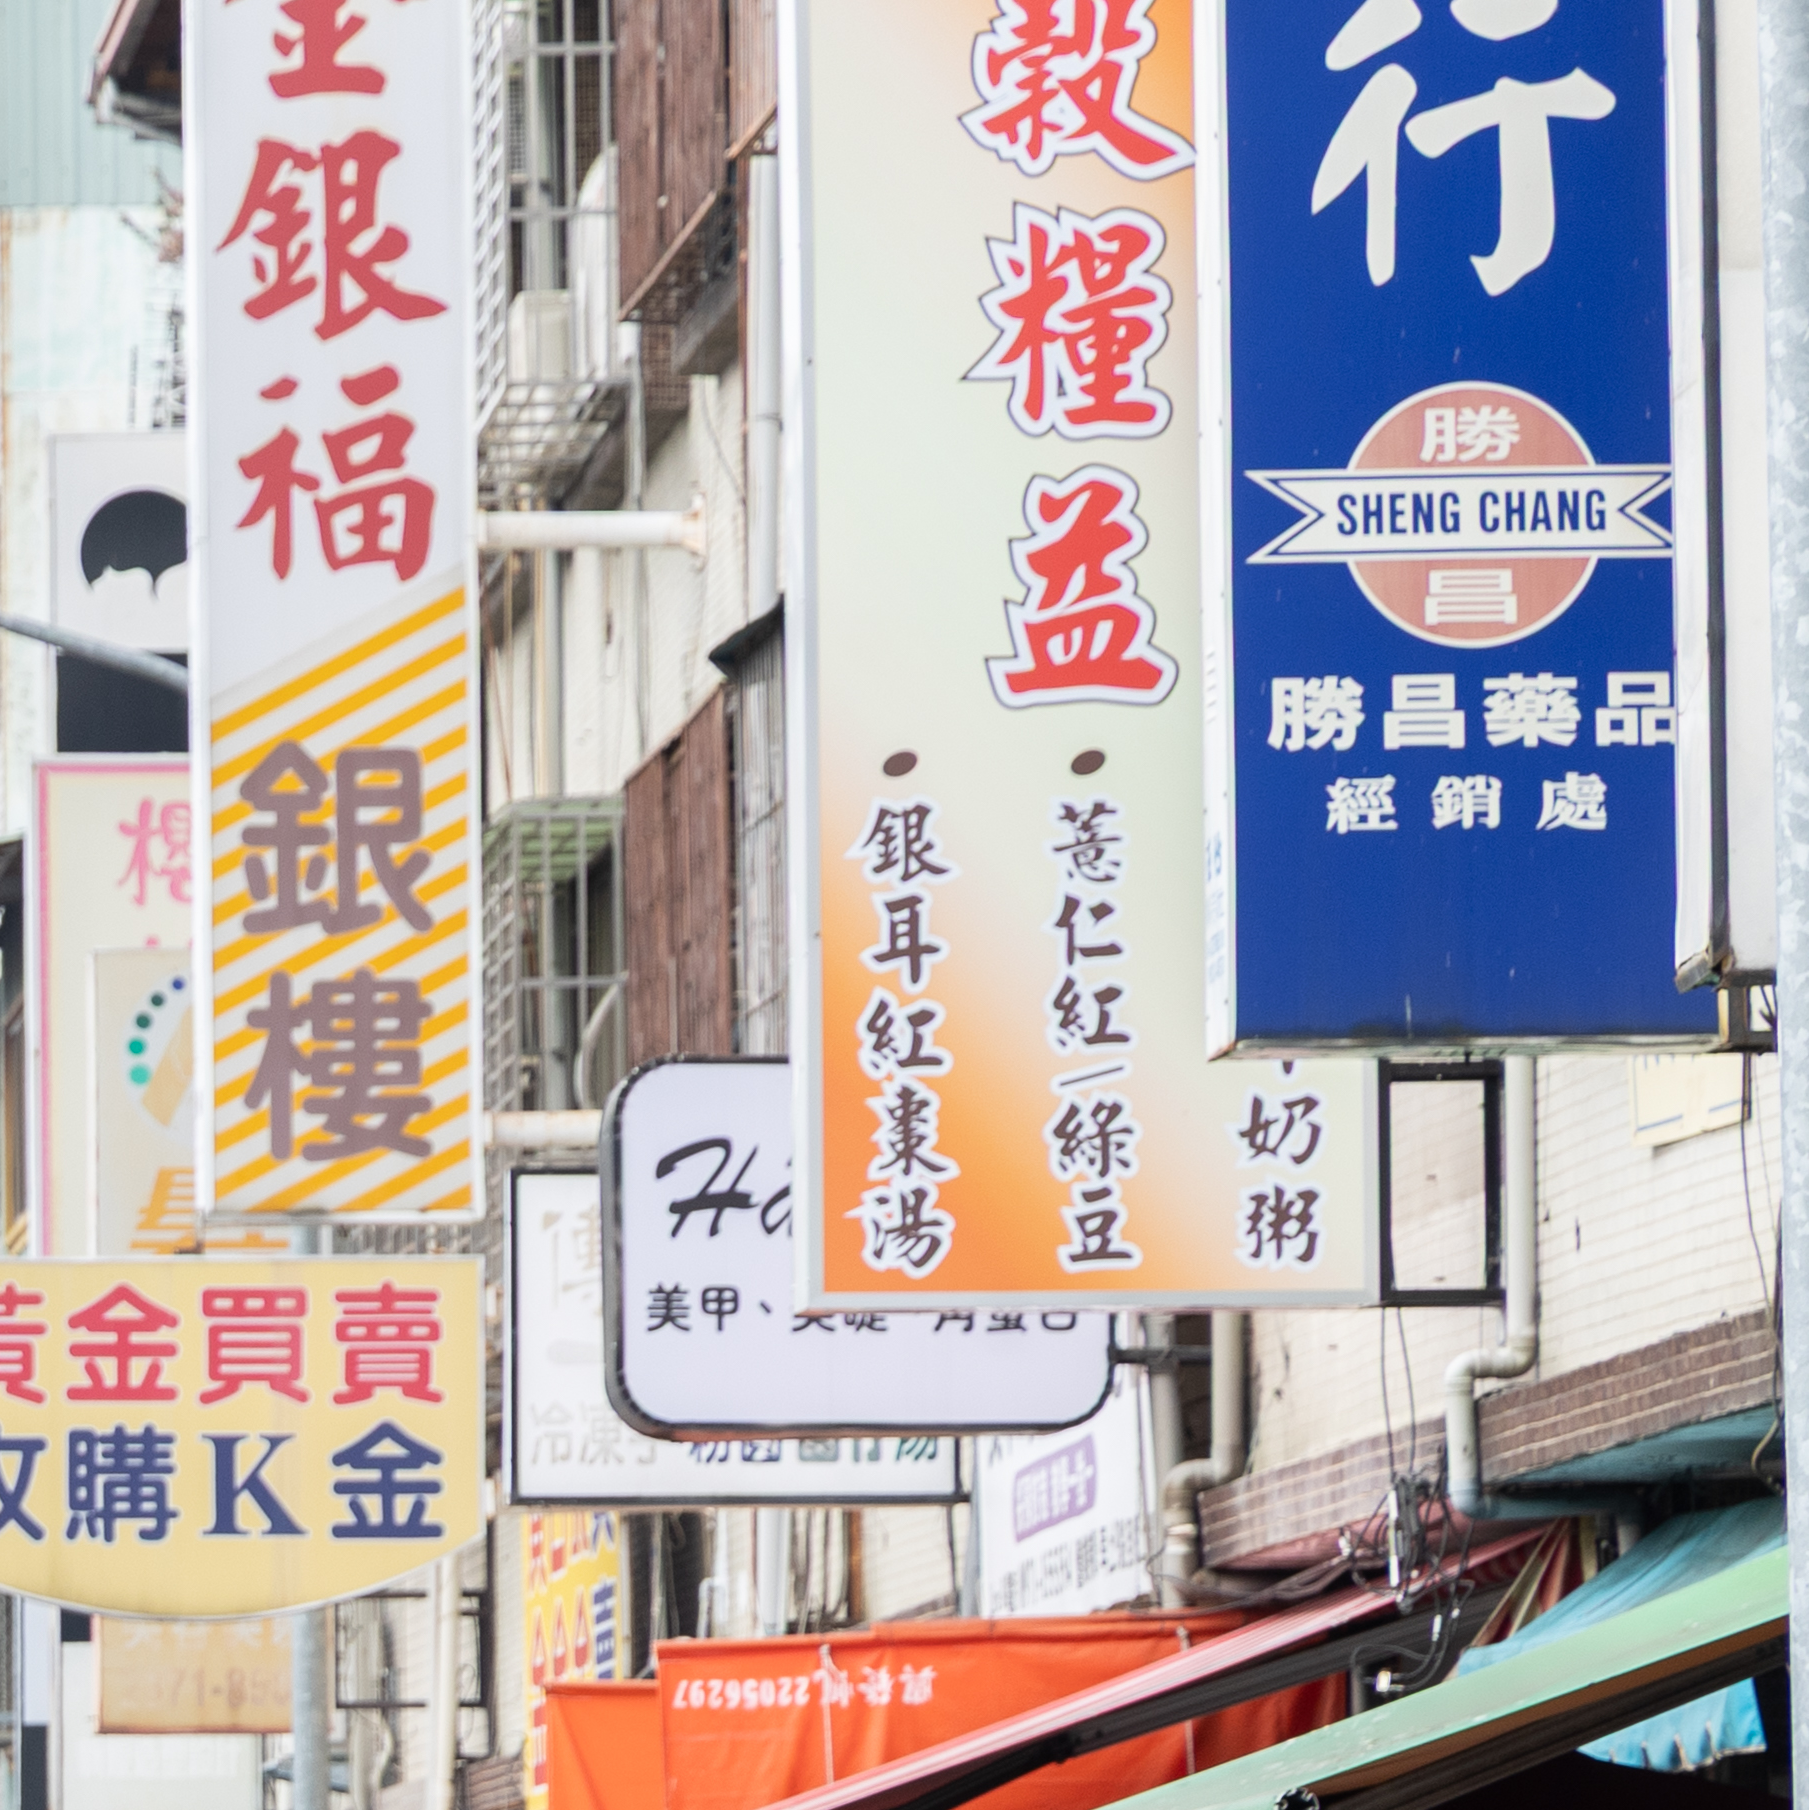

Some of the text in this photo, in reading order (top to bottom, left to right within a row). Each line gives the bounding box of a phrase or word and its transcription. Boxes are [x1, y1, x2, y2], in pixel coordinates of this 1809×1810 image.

[1311, 0, 1618, 298] 行
[973, 0, 1189, 702] 穀糧益
[1419, 405, 1522, 463] 勝
[1337, 488, 1609, 538] SHENG CHANG
[1423, 568, 1520, 626] 昌
[1269, 671, 1676, 751] 勝昌藥品
[1324, 771, 1610, 834] 經銷處
[239, 738, 434, 1164] 銀樓
[862, 803, 951, 1272] 銀耳紅棗湯
[1237, 1058, 1325, 1266] 奶粥
